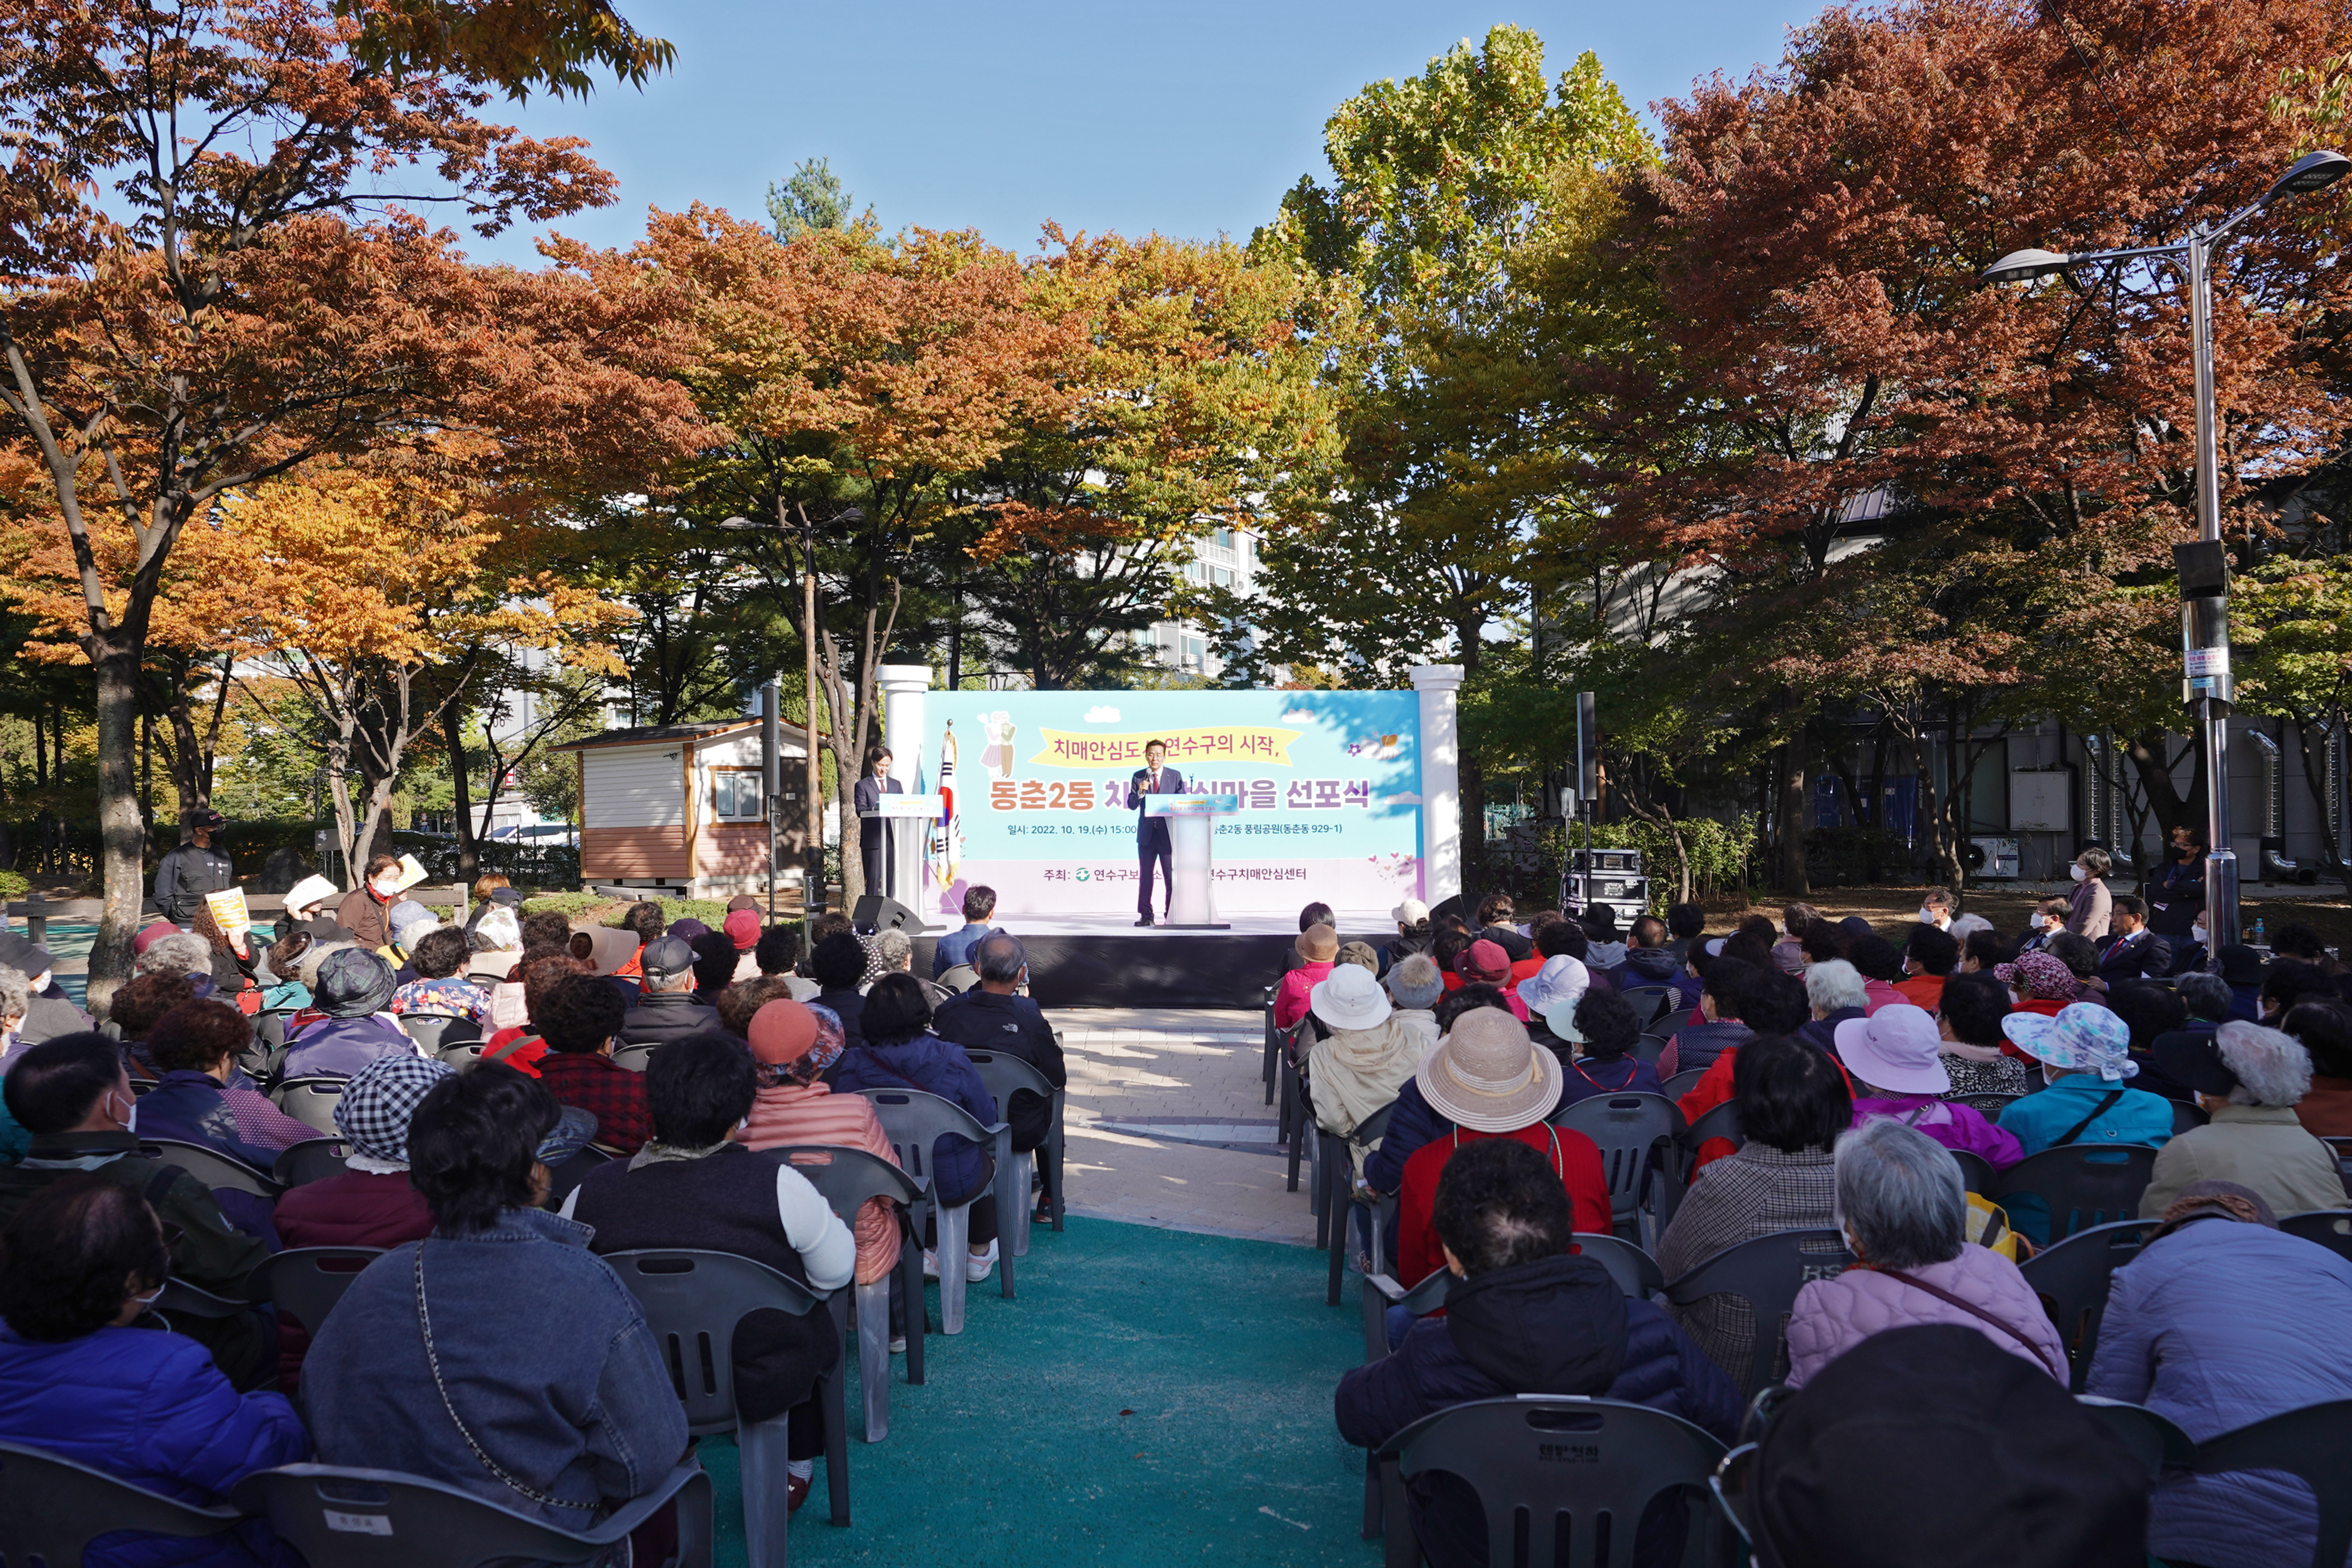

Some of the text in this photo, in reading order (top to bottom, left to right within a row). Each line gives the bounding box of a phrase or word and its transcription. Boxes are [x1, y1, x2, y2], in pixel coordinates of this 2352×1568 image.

[1054, 734, 1279, 762] 치매안심도 연수구의 시작,
[990, 780, 1094, 810] 동춘2동
[1286, 780, 1368, 808] 선포식
[1008, 825, 1029, 835] 일시:
[1031, 825, 1058, 835] 2022.
[1061, 825, 1075, 835] 10.
[1078, 825, 1108, 835] 19.(수)
[1110, 825, 1137, 834] 15:00
[1311, 824, 1342, 834] 929-1)
[1043, 869, 1070, 881] 주최:
[1094, 869, 1163, 881] 연수구보소
